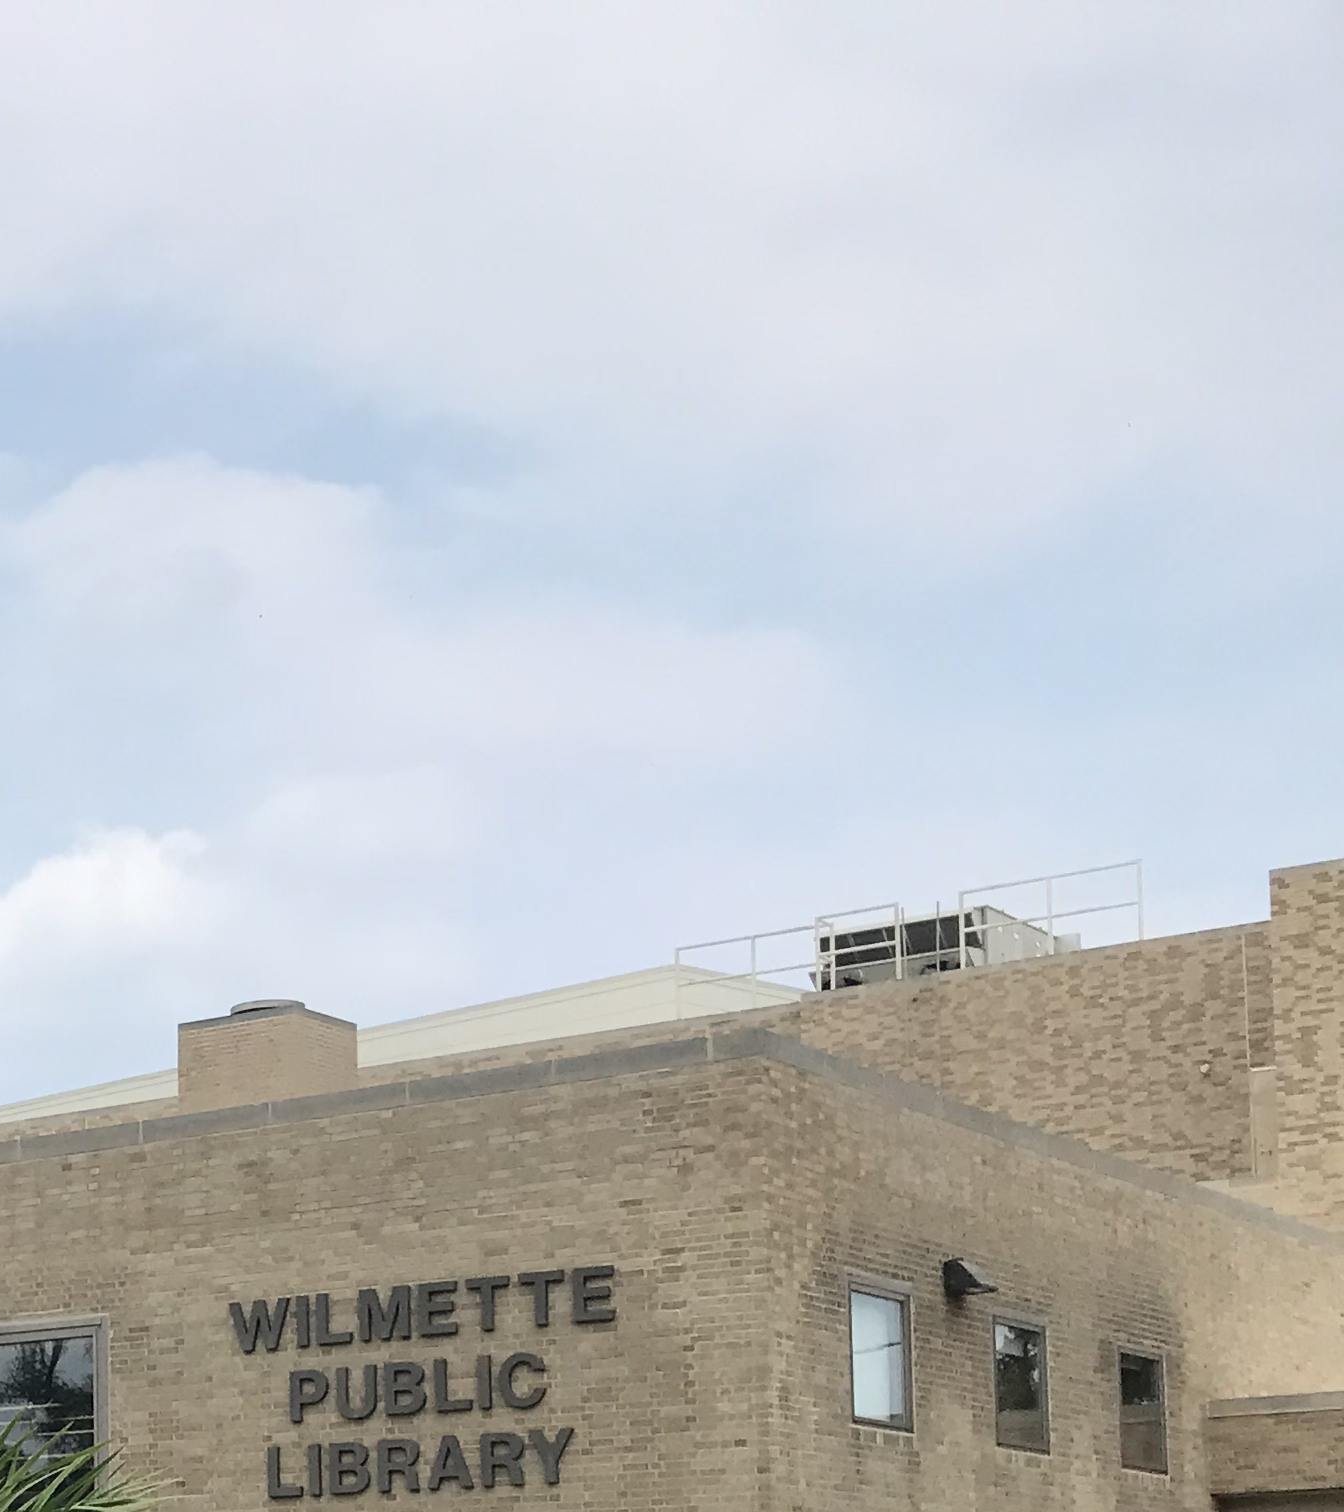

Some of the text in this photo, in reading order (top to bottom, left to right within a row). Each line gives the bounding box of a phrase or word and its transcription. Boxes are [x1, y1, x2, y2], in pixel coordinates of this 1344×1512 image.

[228, 1264, 616, 1354] WILMETTE
[289, 1352, 548, 1423] PUBLIC
[266, 1427, 575, 1499] LIBRARY
